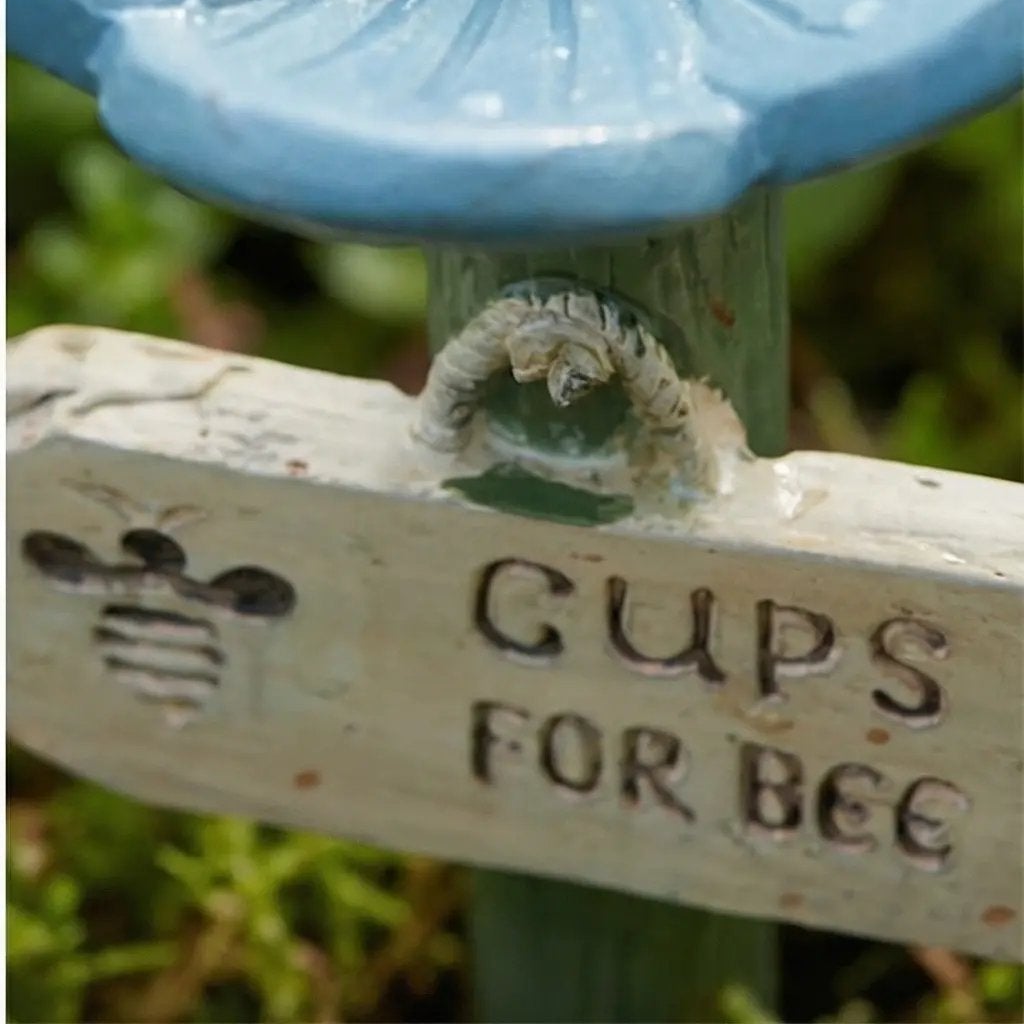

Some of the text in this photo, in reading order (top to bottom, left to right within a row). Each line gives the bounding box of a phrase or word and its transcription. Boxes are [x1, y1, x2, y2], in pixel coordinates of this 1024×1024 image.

[474, 556, 950, 727] CUPS
[470, 699, 969, 866] FOR BEE
